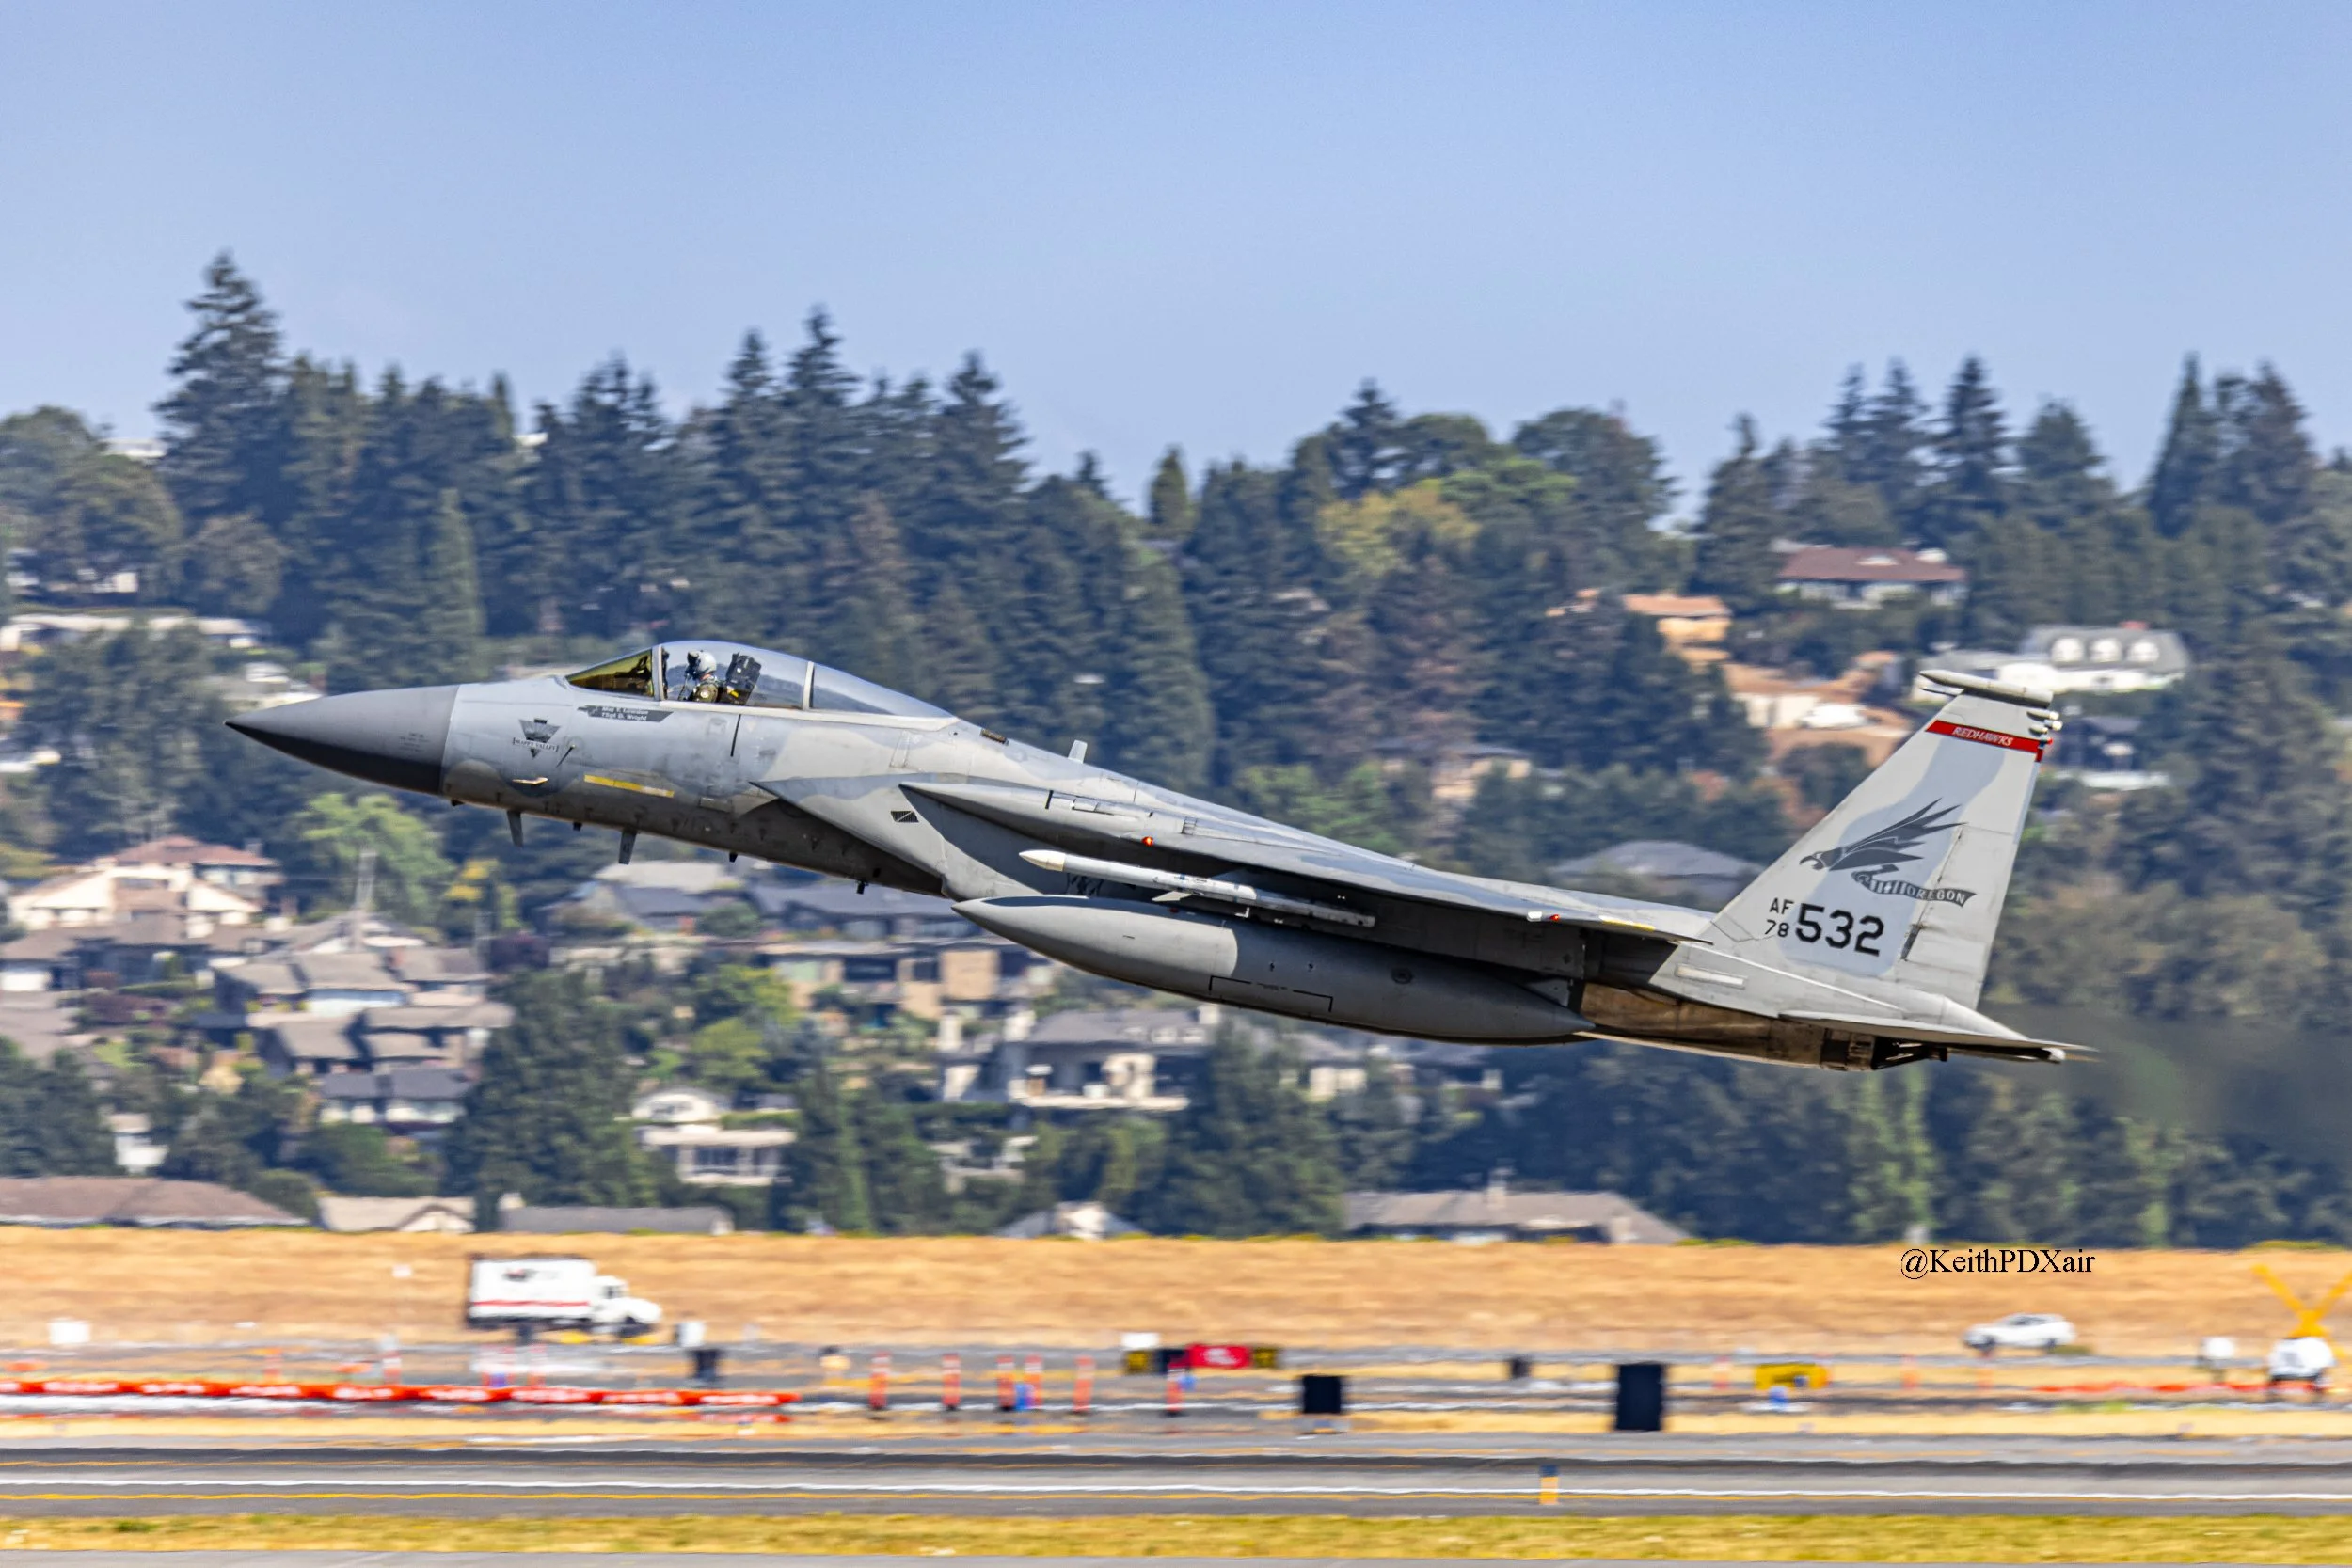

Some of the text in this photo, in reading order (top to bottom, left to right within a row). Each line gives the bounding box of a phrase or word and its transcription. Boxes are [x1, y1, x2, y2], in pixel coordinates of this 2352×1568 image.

[1951, 726, 2014, 747] REDHAWKS
[1906, 884, 1965, 905] OREGON
[1769, 897, 1795, 914] AF
[1764, 918, 1790, 938] 78
[1795, 902, 1884, 958] 532
